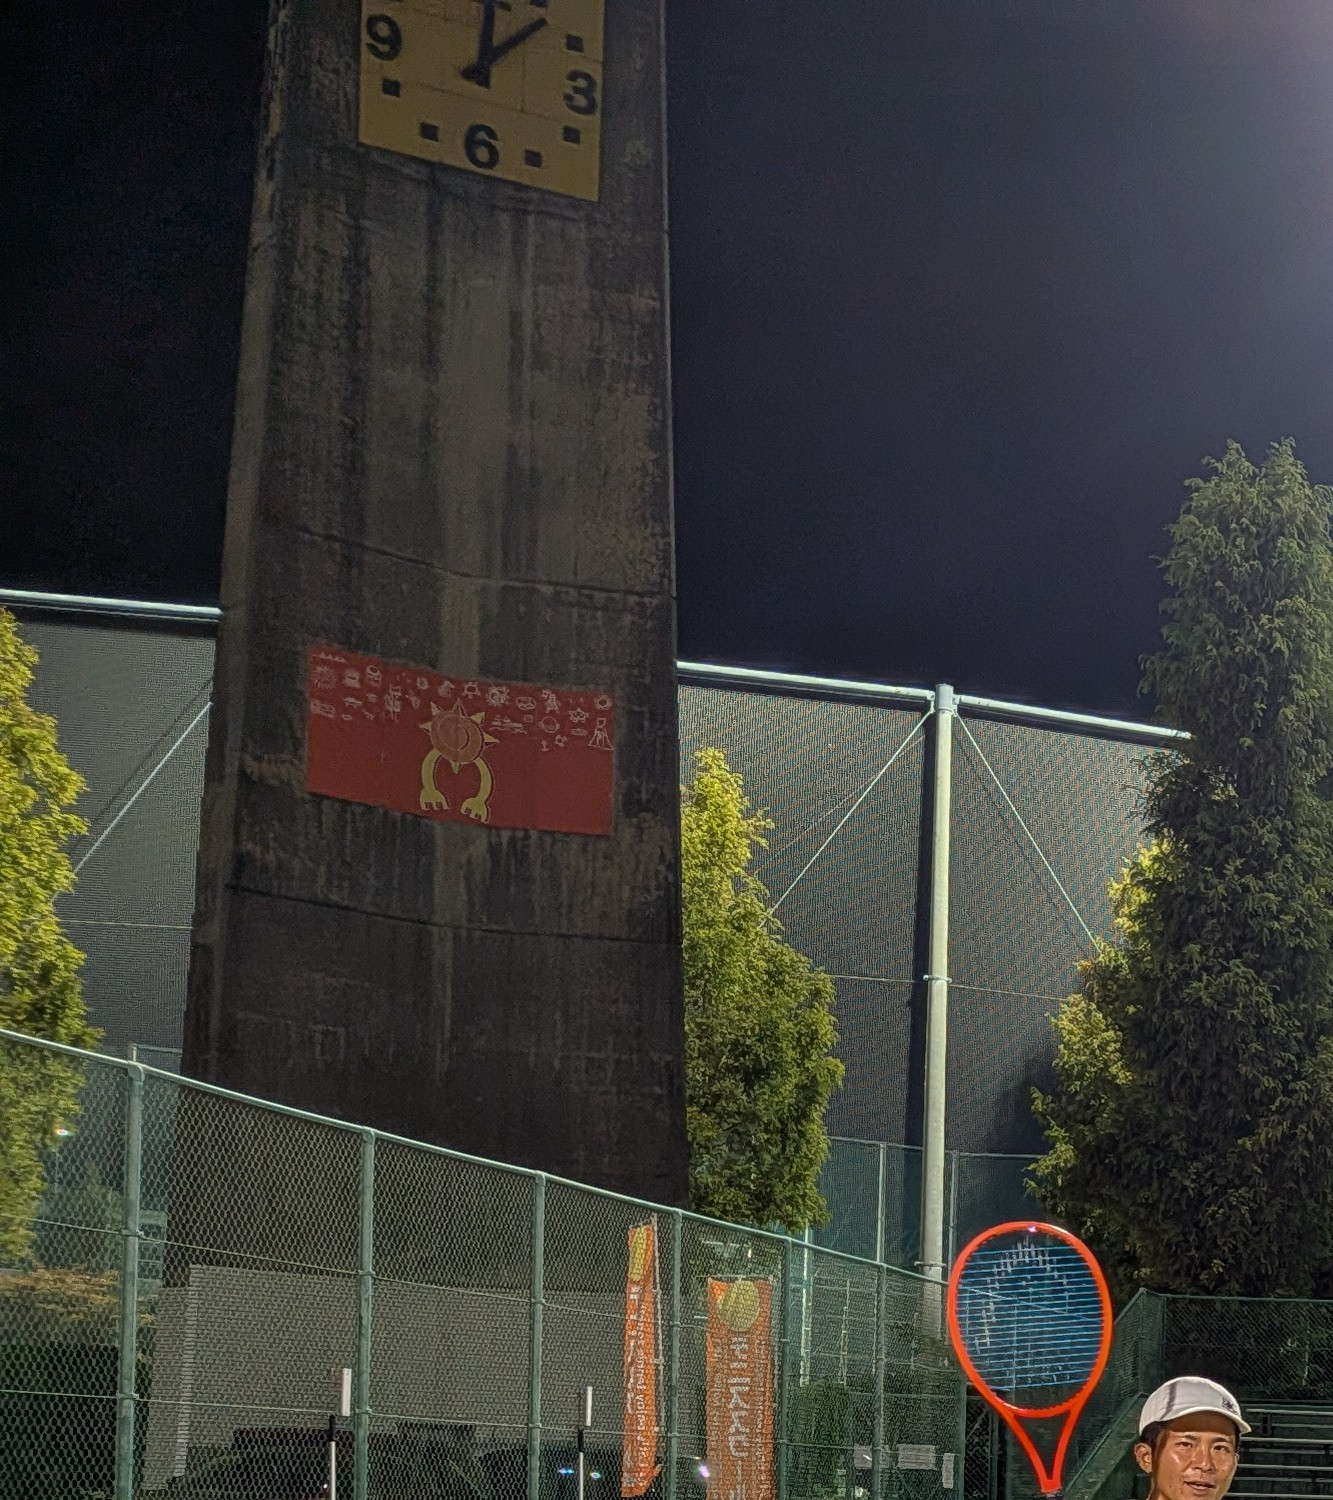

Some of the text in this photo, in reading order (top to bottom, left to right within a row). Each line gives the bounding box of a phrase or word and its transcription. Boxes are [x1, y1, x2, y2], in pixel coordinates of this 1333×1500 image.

[365, 13, 403, 62] 9
[562, 69, 598, 116] 3
[463, 123, 500, 170] 6
